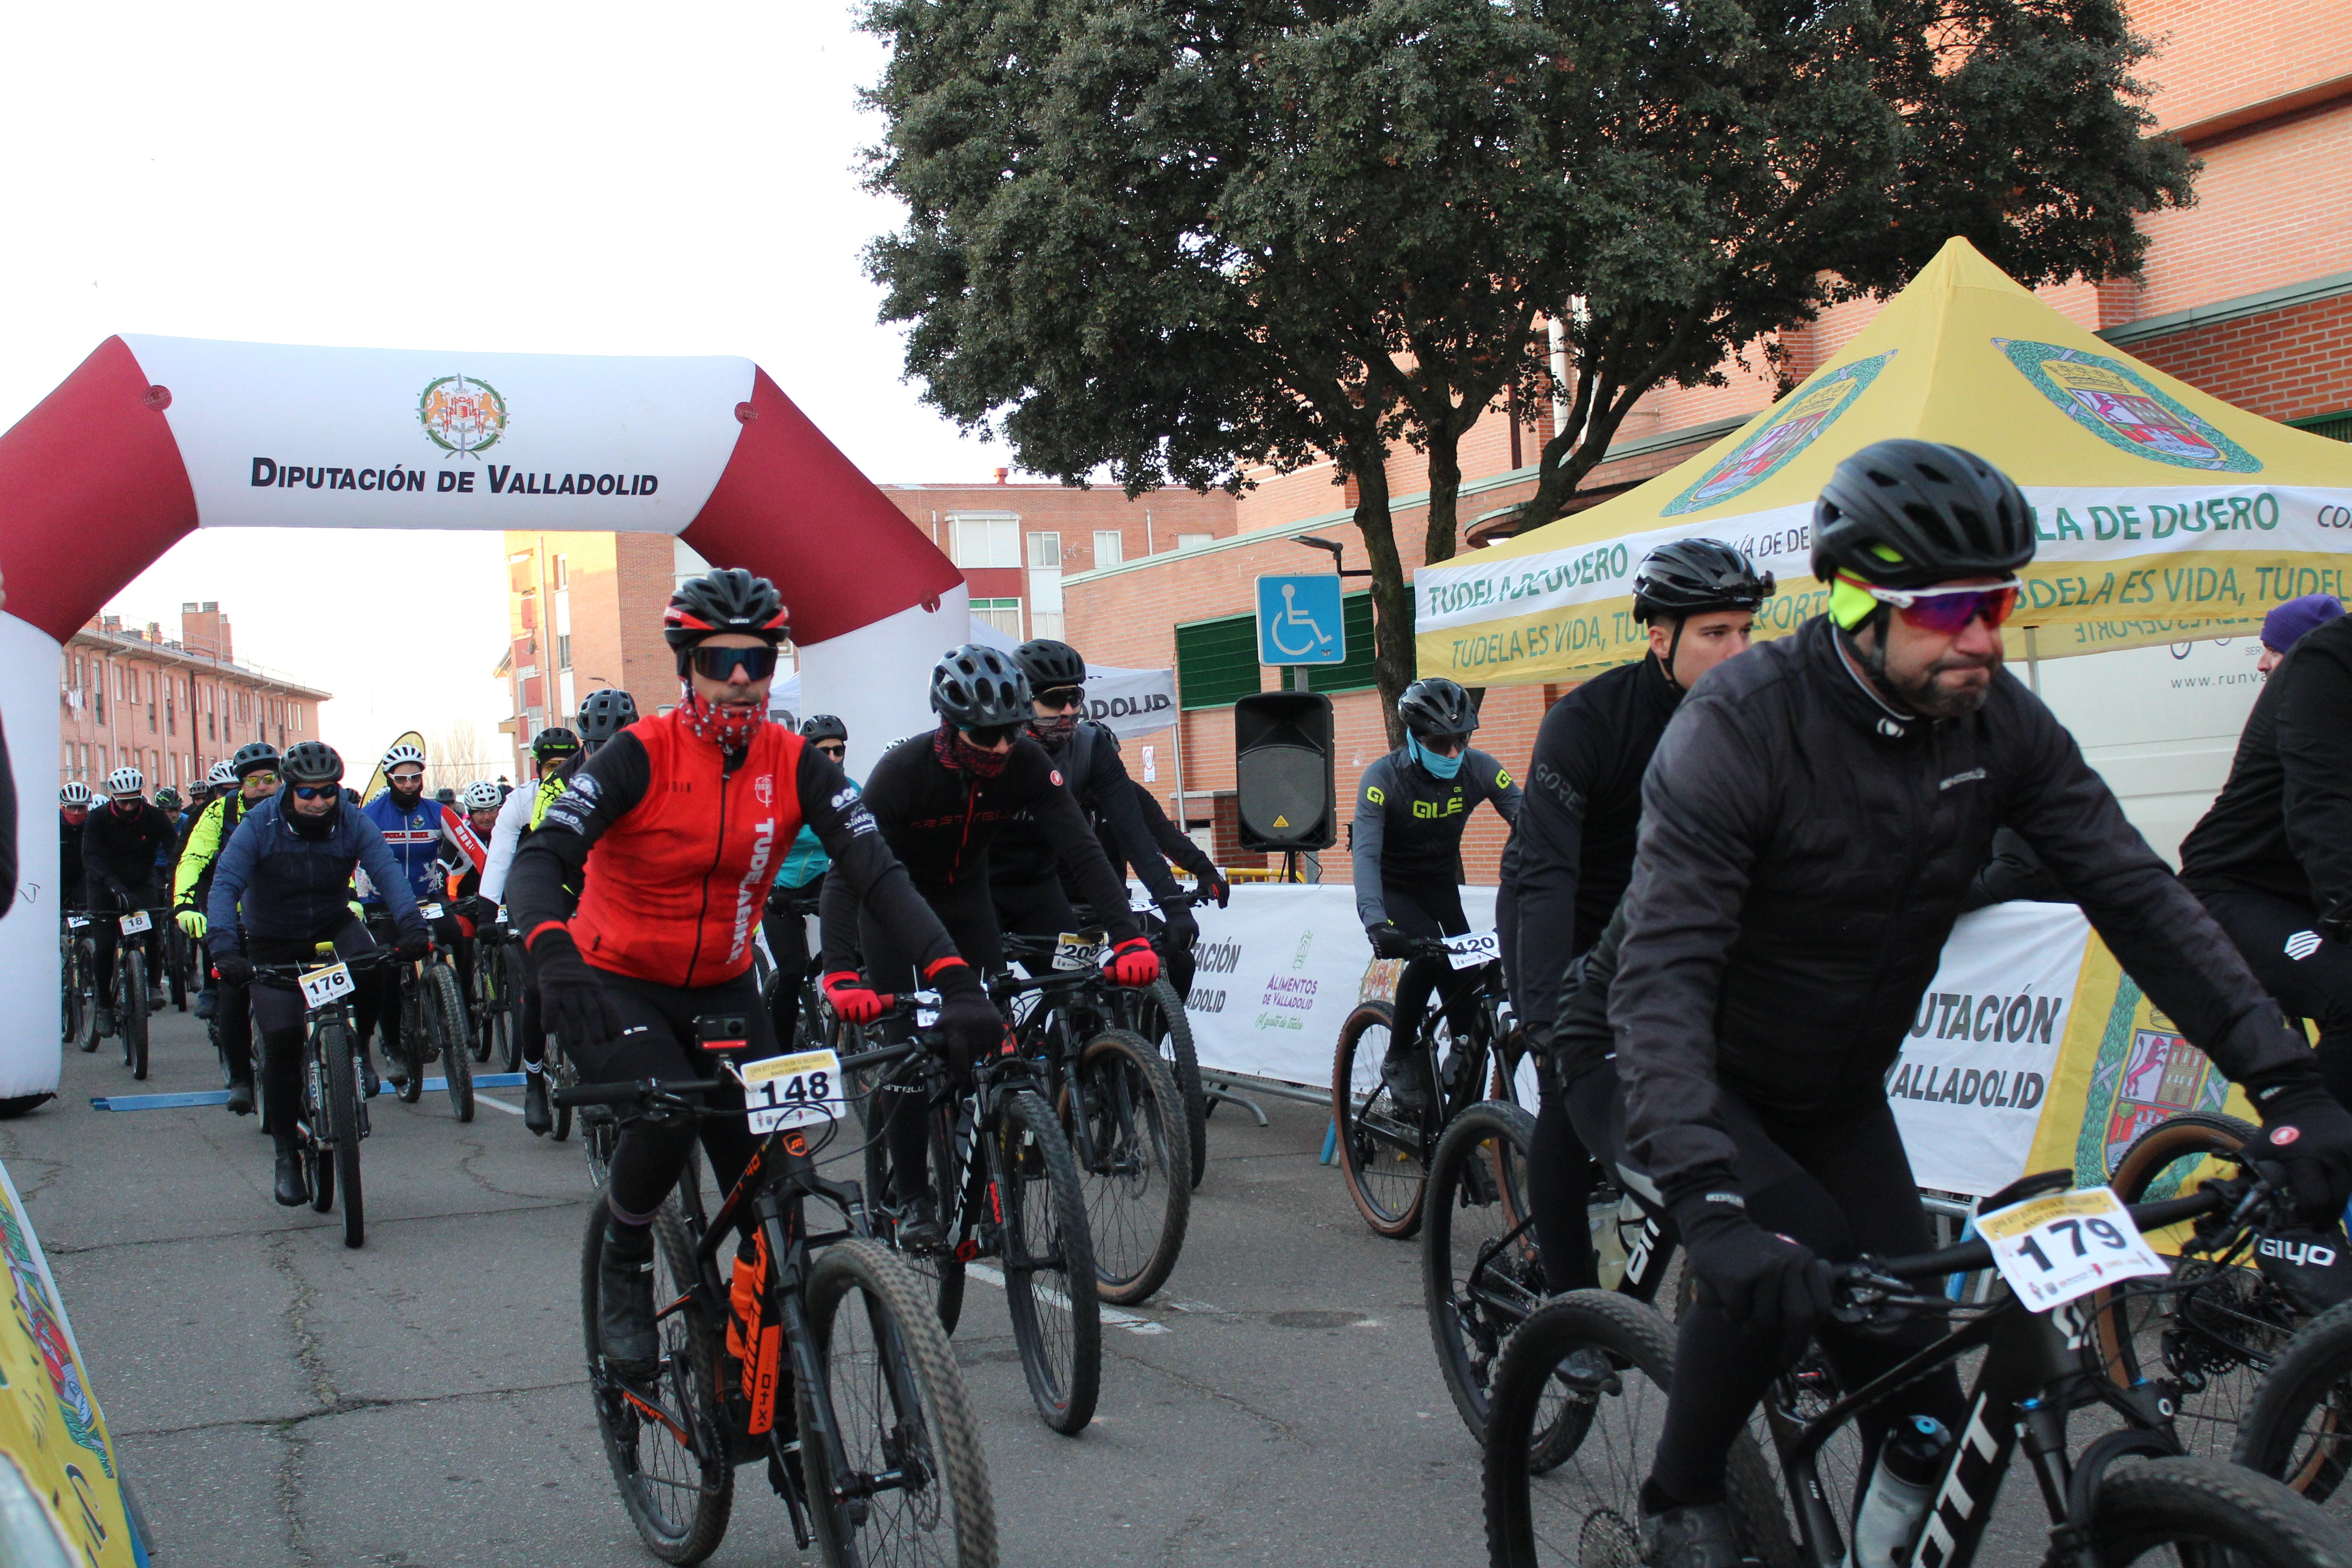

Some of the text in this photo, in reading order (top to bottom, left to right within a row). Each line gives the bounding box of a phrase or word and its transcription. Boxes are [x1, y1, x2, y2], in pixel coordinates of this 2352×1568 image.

[251, 457, 659, 496] DIPUTACIÓN DE VALLADOLID
[2087, 505, 2141, 540] DE
[2148, 492, 2279, 540] DUERO
[2318, 505, 2352, 529] CO
[1759, 531, 1783, 558] DE
[1429, 575, 1511, 616] TUDELA
[2119, 569, 2157, 604] ES
[2164, 567, 2246, 607] VIDA,
[1452, 630, 1524, 669] TUDELA
[1528, 625, 1549, 657] ES
[1555, 616, 1607, 652] VIDA,
[1535, 763, 1581, 810] GORE
[726, 817, 774, 965] TUDELABIKE
[128, 917, 143, 927] 18
[1455, 937, 1495, 955] 420
[309, 972, 345, 995] 176
[1262, 992, 1313, 1010] DE VALLADOLID
[1266, 973, 1318, 995] ALIMENTOS
[1287, 1016, 1303, 1030] todos
[760, 1071, 829, 1106] 148
[2017, 1218, 2127, 1272] 179
